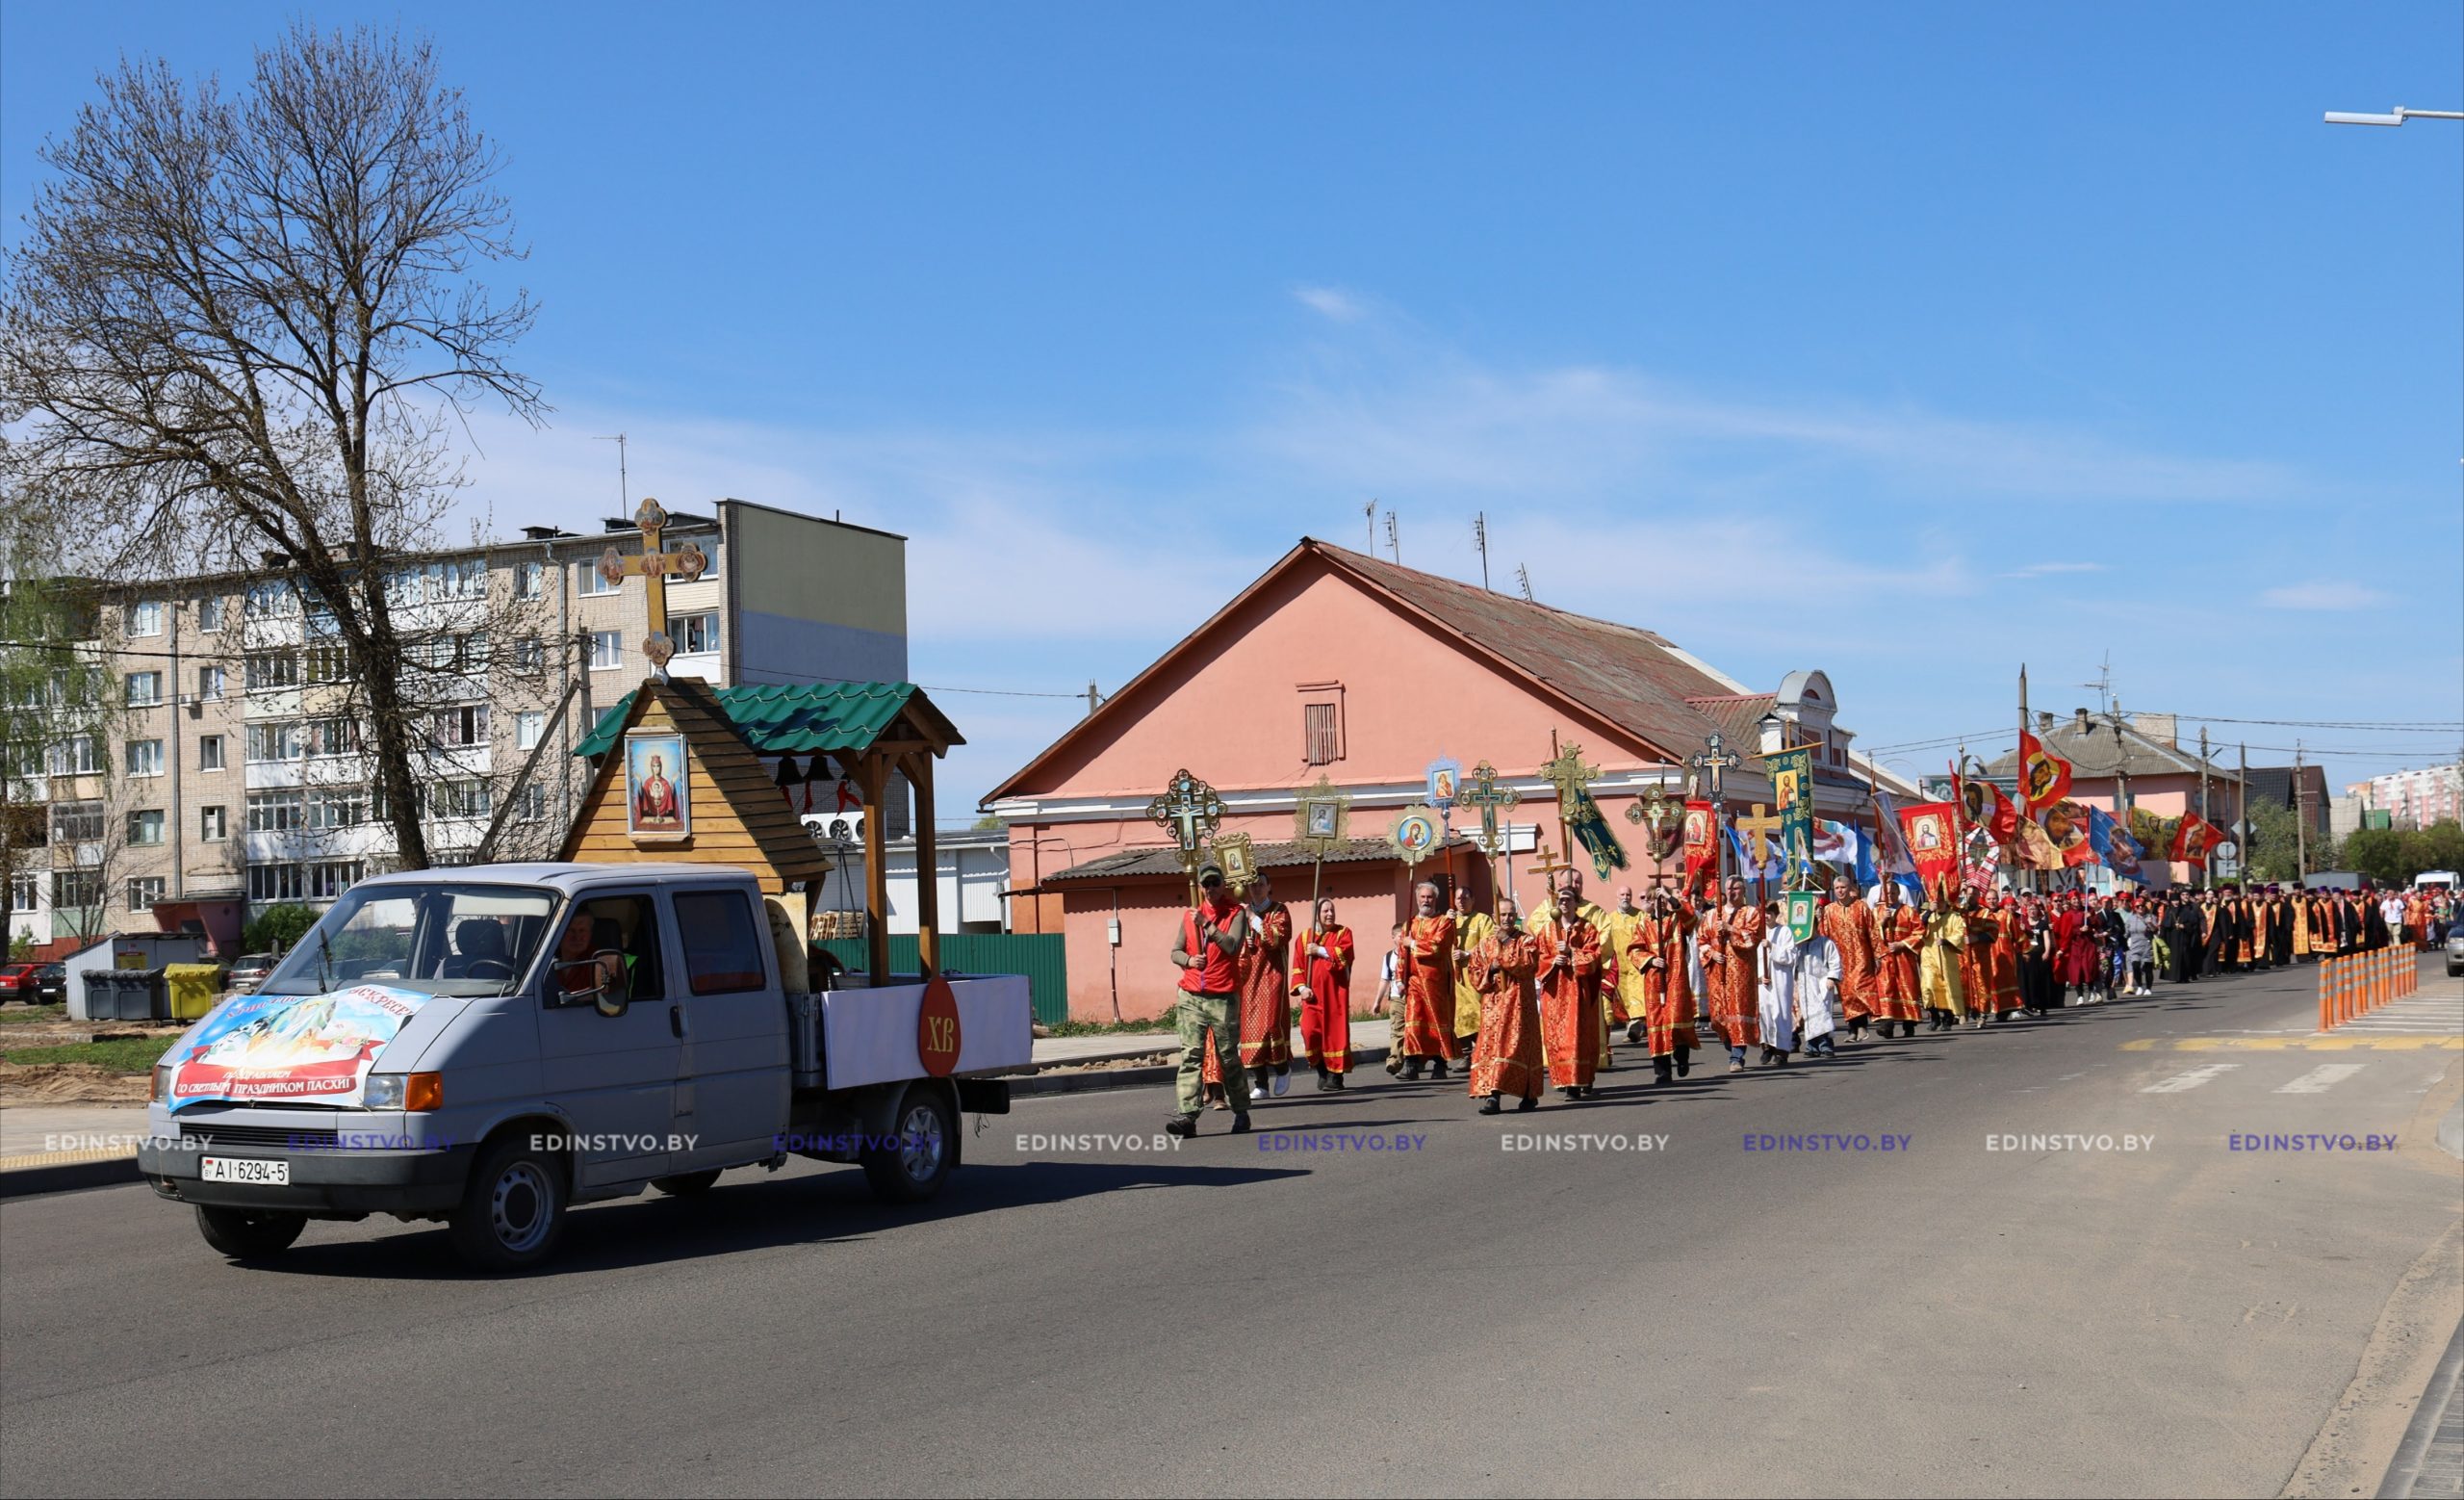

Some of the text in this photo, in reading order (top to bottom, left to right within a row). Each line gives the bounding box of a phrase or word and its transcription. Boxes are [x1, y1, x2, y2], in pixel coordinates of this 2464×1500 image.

[927, 1016, 954, 1052] ХВ
[234, 1081, 304, 1095] ПРАЗДНИКОМ
[307, 1077, 350, 1092] ПАСХИ!
